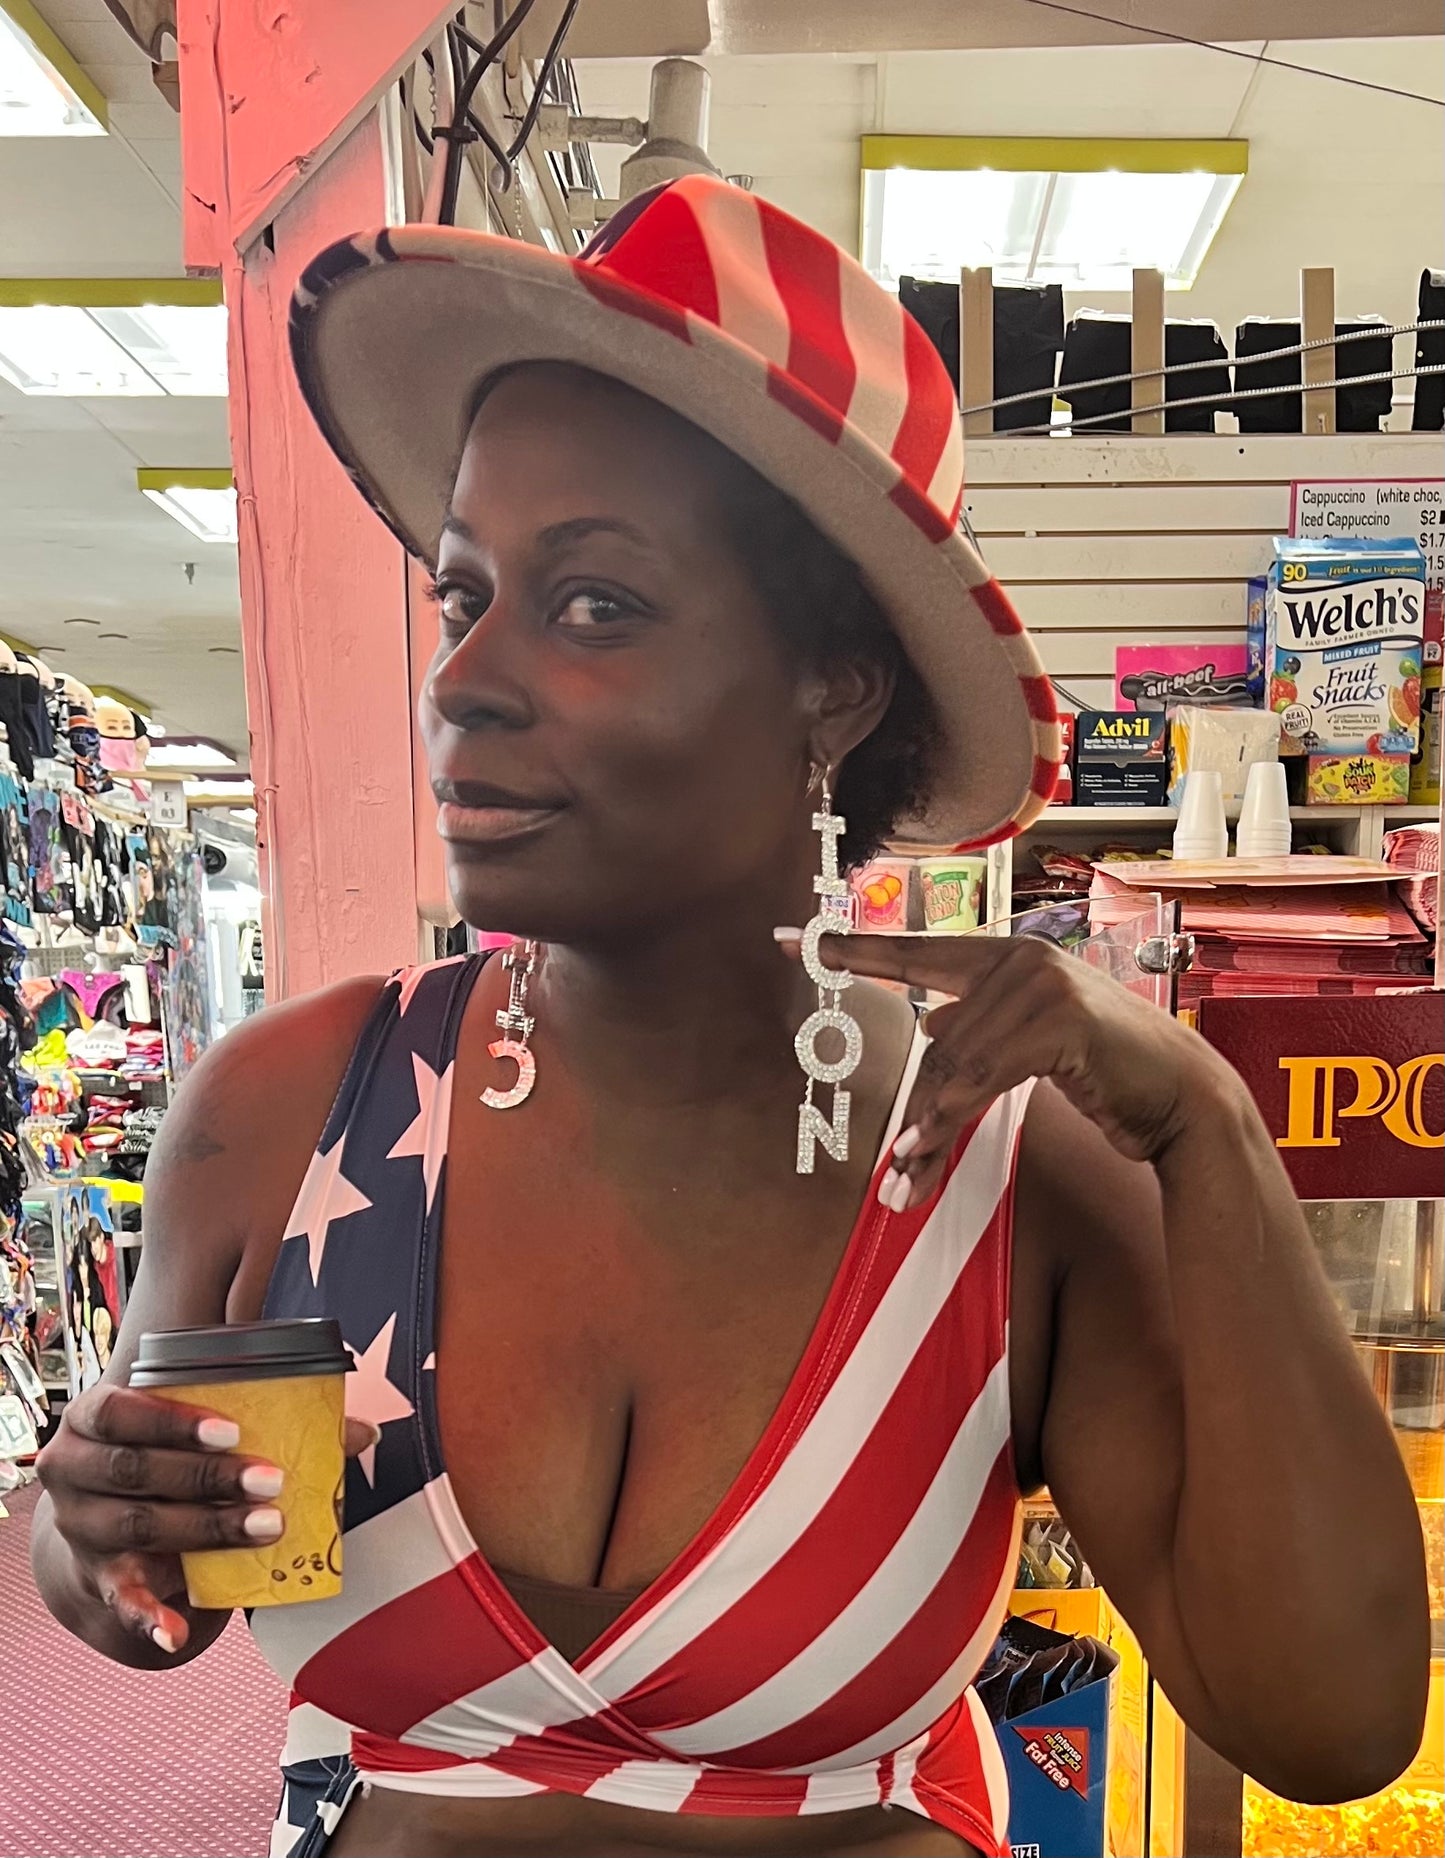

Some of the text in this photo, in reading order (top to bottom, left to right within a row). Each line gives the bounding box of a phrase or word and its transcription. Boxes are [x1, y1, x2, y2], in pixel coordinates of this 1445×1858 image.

[1302, 487, 1442, 507] Cappuccino (white choc,
[1301, 512, 1323, 527] Iced
[1327, 511, 1390, 530] Cappuccino
[1283, 564, 1307, 581] 90
[1283, 588, 1419, 639] Welch's
[1305, 626, 1395, 647] FAMILY FARMER OWNED
[1324, 645, 1380, 662] MIXED FRUIT
[1328, 662, 1379, 688] Fruit
[1310, 682, 1387, 709] Snacks
[1285, 711, 1305, 721] REAL
[1091, 717, 1150, 737] Advil
[1044, 1734, 1082, 1772] FRUIT JUICE
[1054, 1732, 1082, 1762] Intense
[1024, 1741, 1070, 1788] Fat Free
